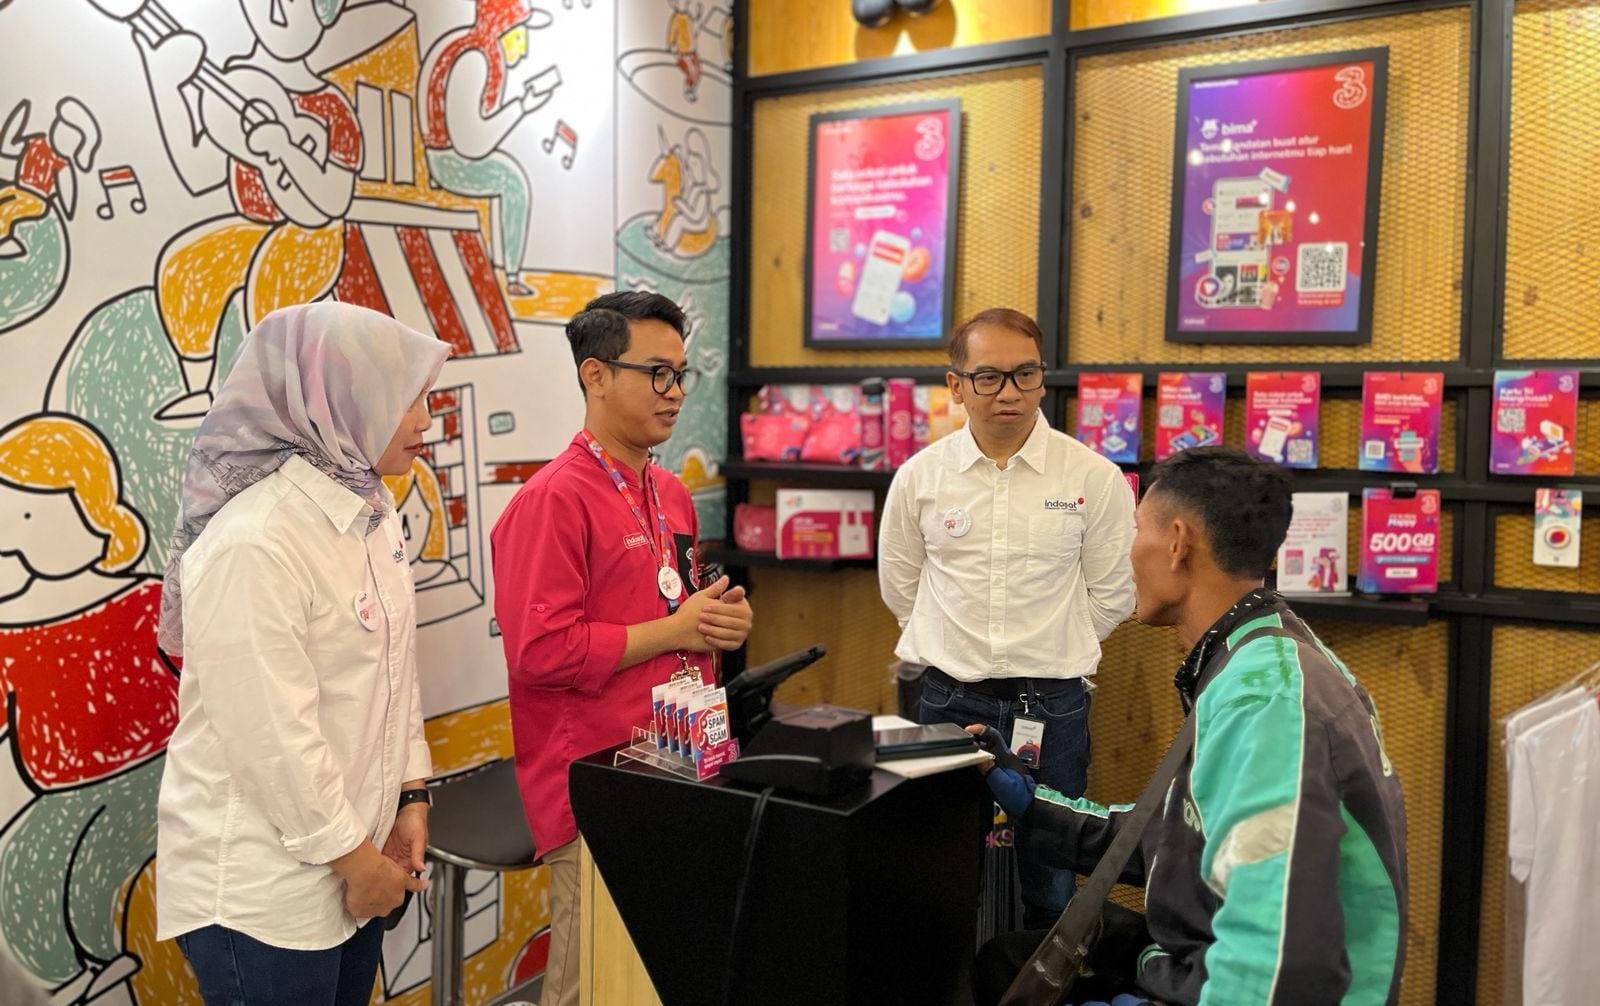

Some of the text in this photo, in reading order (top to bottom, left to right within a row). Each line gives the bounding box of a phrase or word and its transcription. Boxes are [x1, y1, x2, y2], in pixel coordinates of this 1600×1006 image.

[1333, 66, 1366, 109] 3
[914, 117, 945, 161] 3
[1369, 532, 1436, 553] 500 GB
[708, 714, 726, 729] SPAM
[709, 729, 727, 744] SCAM
